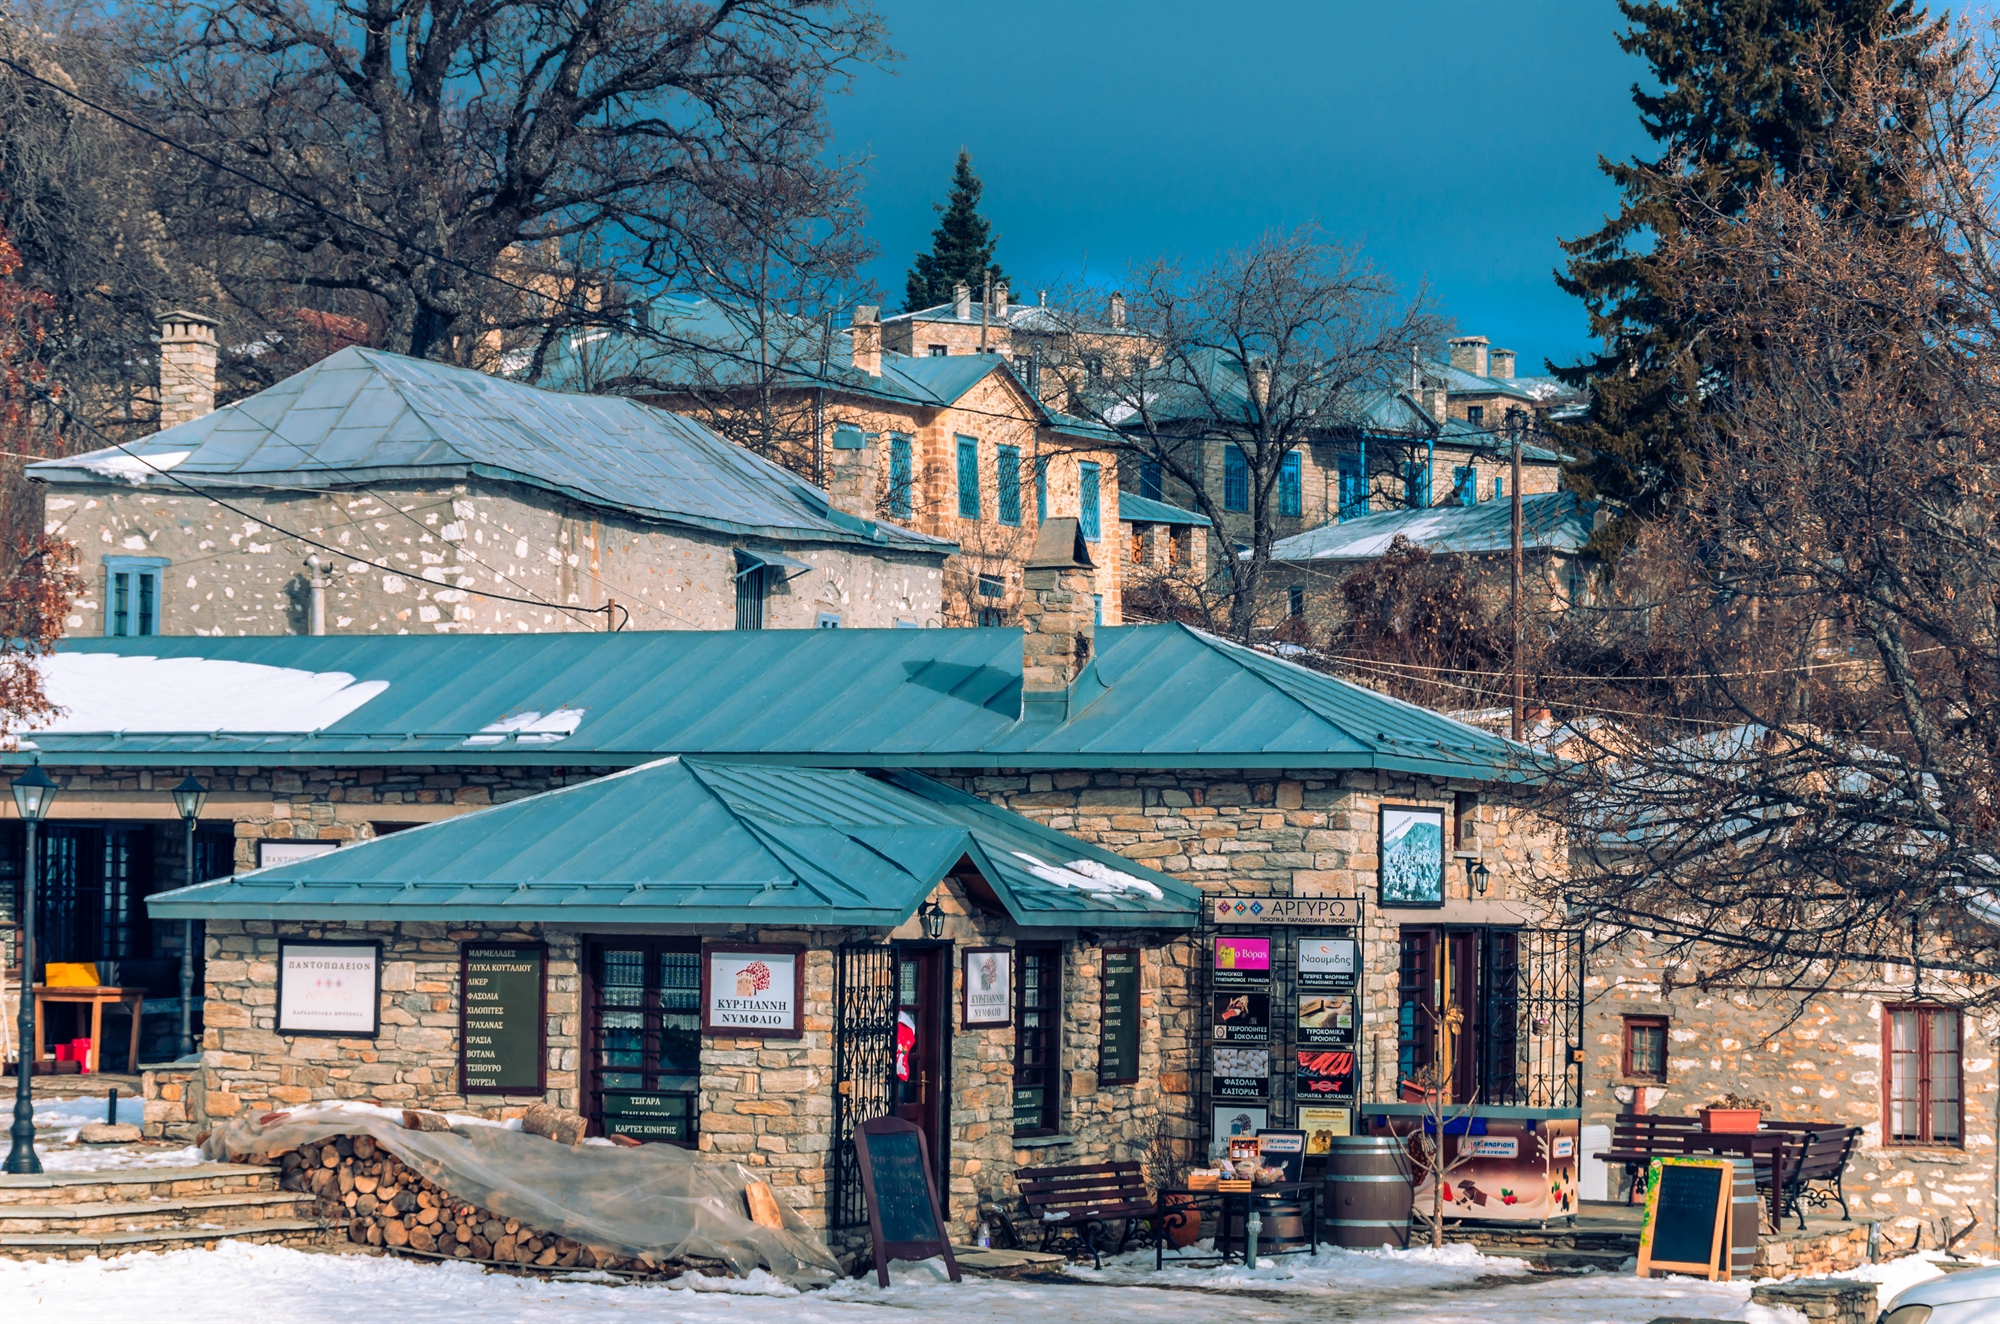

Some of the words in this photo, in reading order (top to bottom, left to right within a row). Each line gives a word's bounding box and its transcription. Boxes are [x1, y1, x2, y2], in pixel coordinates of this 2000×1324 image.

[1271, 901, 1345, 917] ΑΡΓΥΡΩ
[468, 949, 516, 958] ΜΑΡΜΕΛΑΔΕΣ
[1235, 950, 1241, 958] ο
[1242, 948, 1267, 961] Βόρας
[1301, 954, 1351, 967] Ναουμιδης
[288, 961, 371, 970] ΠΑΝΤΟΠΩΛΕΙΟΝ
[468, 963, 491, 972] ΓΛΥΚΑ
[491, 964, 532, 972] ΚΟΥΤΑΛΙΟΥ
[467, 978, 489, 986] ΛΙΚΕΡ
[466, 992, 499, 1000] ΦΑΣΟΛΙΑ
[466, 1006, 504, 1014] ΧΙΛΟΠΙΤΕΣ
[974, 1008, 1001, 1018] ΝΥΜΦΑΙΟ
[722, 1014, 781, 1024] ΝΥΜΦΑΙΟ
[466, 1021, 503, 1029] ΤΡΑΧΑΝΑΣ
[1227, 1025, 1268, 1033] ΧΕΙΡΟΠΟΙΗΤΕΣ
[1306, 1028, 1345, 1036] ΤΥΡΟΚΟΜΙΚΑ
[466, 1036, 492, 1044] ΚΡΑΣΙΑ
[466, 1050, 496, 1058] ΒΟΤΑΝΑ
[466, 1063, 502, 1072] ΤΣΙΠΟΥΡΟ
[466, 1078, 497, 1087] ΤΟΥΡΣΙΑ
[1223, 1078, 1257, 1086] ΦΑΣΟΛΙΑ
[1221, 1087, 1259, 1096] ΚΑΣΤΟΡΙΑΣ
[630, 1096, 661, 1106] ΤΣΙΓΑΡΑ
[615, 1124, 643, 1133] ΚΑΡΤΕΣ
[643, 1125, 677, 1135] ΚΙΝΗΤΗΣ
